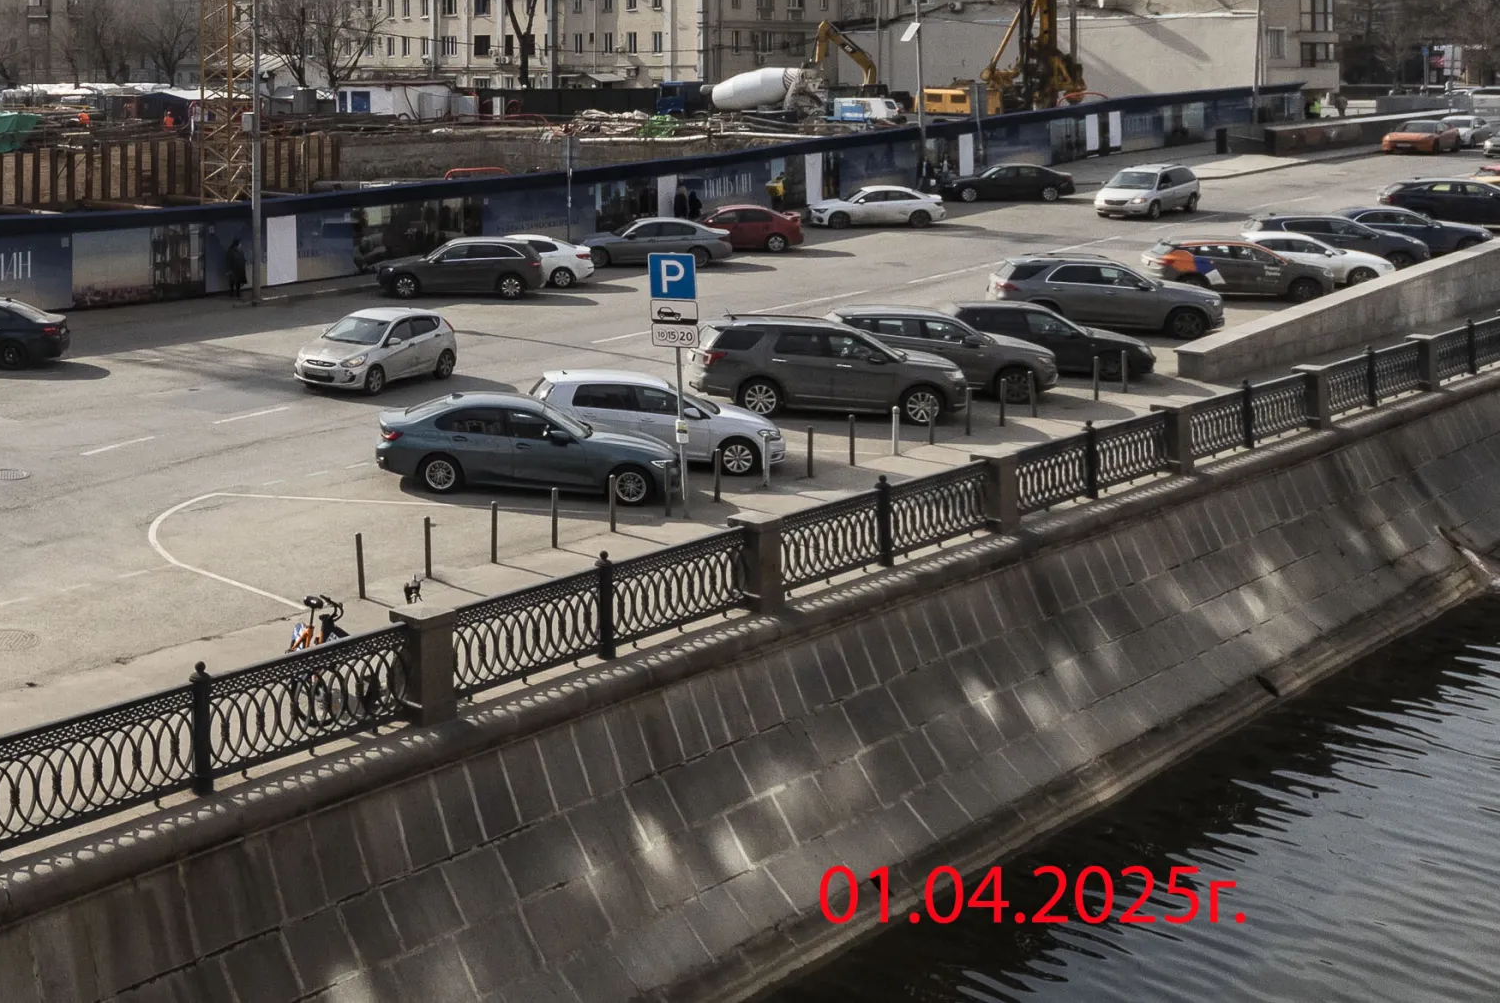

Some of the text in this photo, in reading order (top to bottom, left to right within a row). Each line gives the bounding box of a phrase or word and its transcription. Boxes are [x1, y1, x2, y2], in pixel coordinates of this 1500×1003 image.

[661, 260, 684, 293] P
[667, 331, 676, 340] 15
[680, 331, 693, 341] 20
